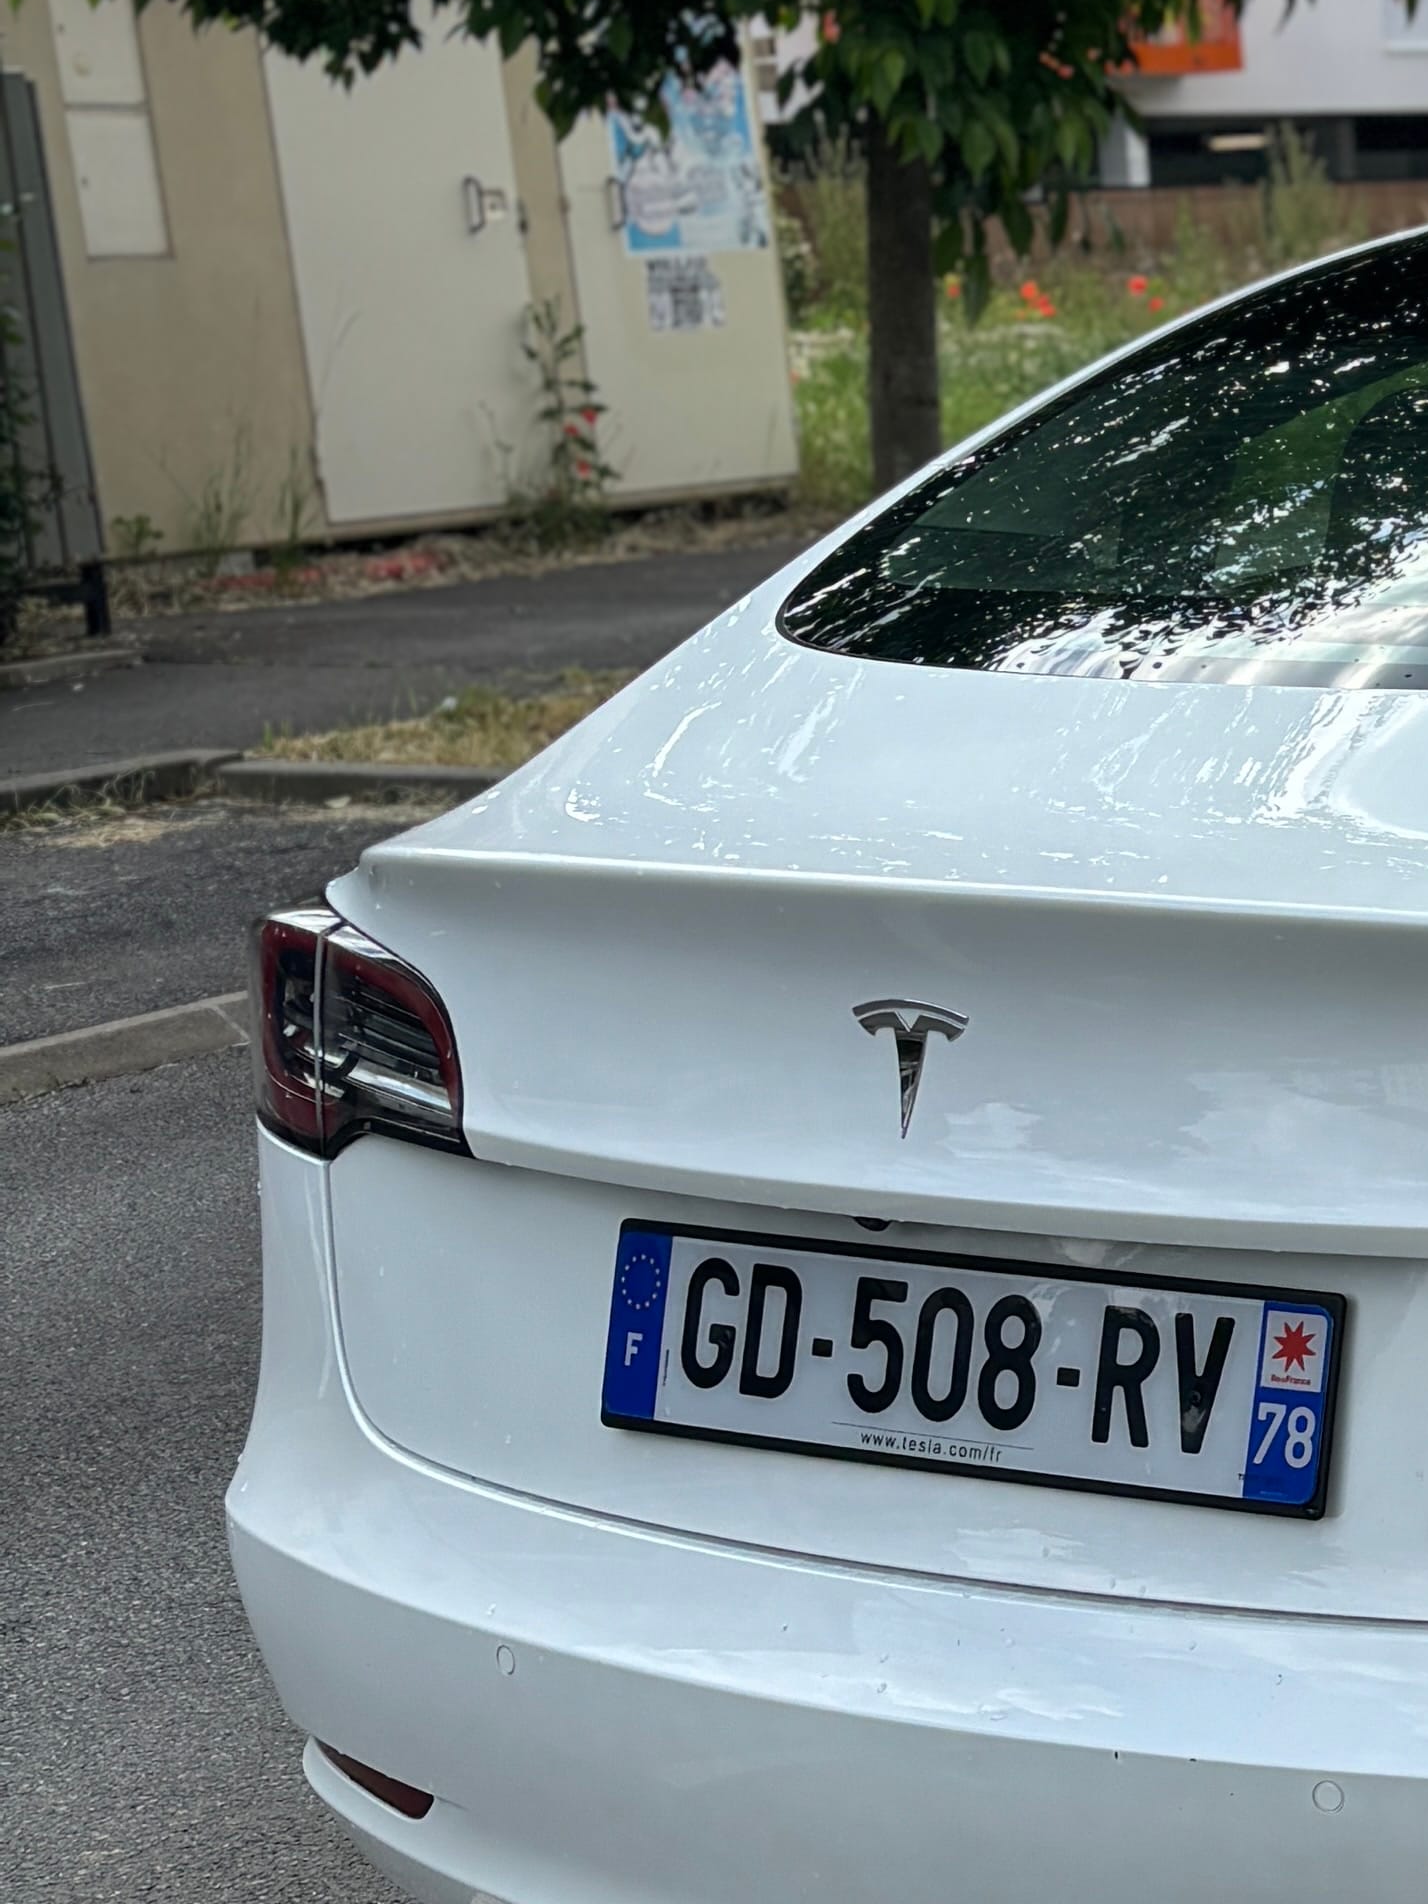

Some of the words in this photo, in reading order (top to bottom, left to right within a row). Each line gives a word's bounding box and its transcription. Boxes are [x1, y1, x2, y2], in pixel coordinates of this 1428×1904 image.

[624, 1332, 643, 1366] F
[680, 1257, 1235, 1455] GD-508-RV
[860, 1432, 1002, 1462] www.tesla.com/fr
[1253, 1402, 1316, 1469] 78
